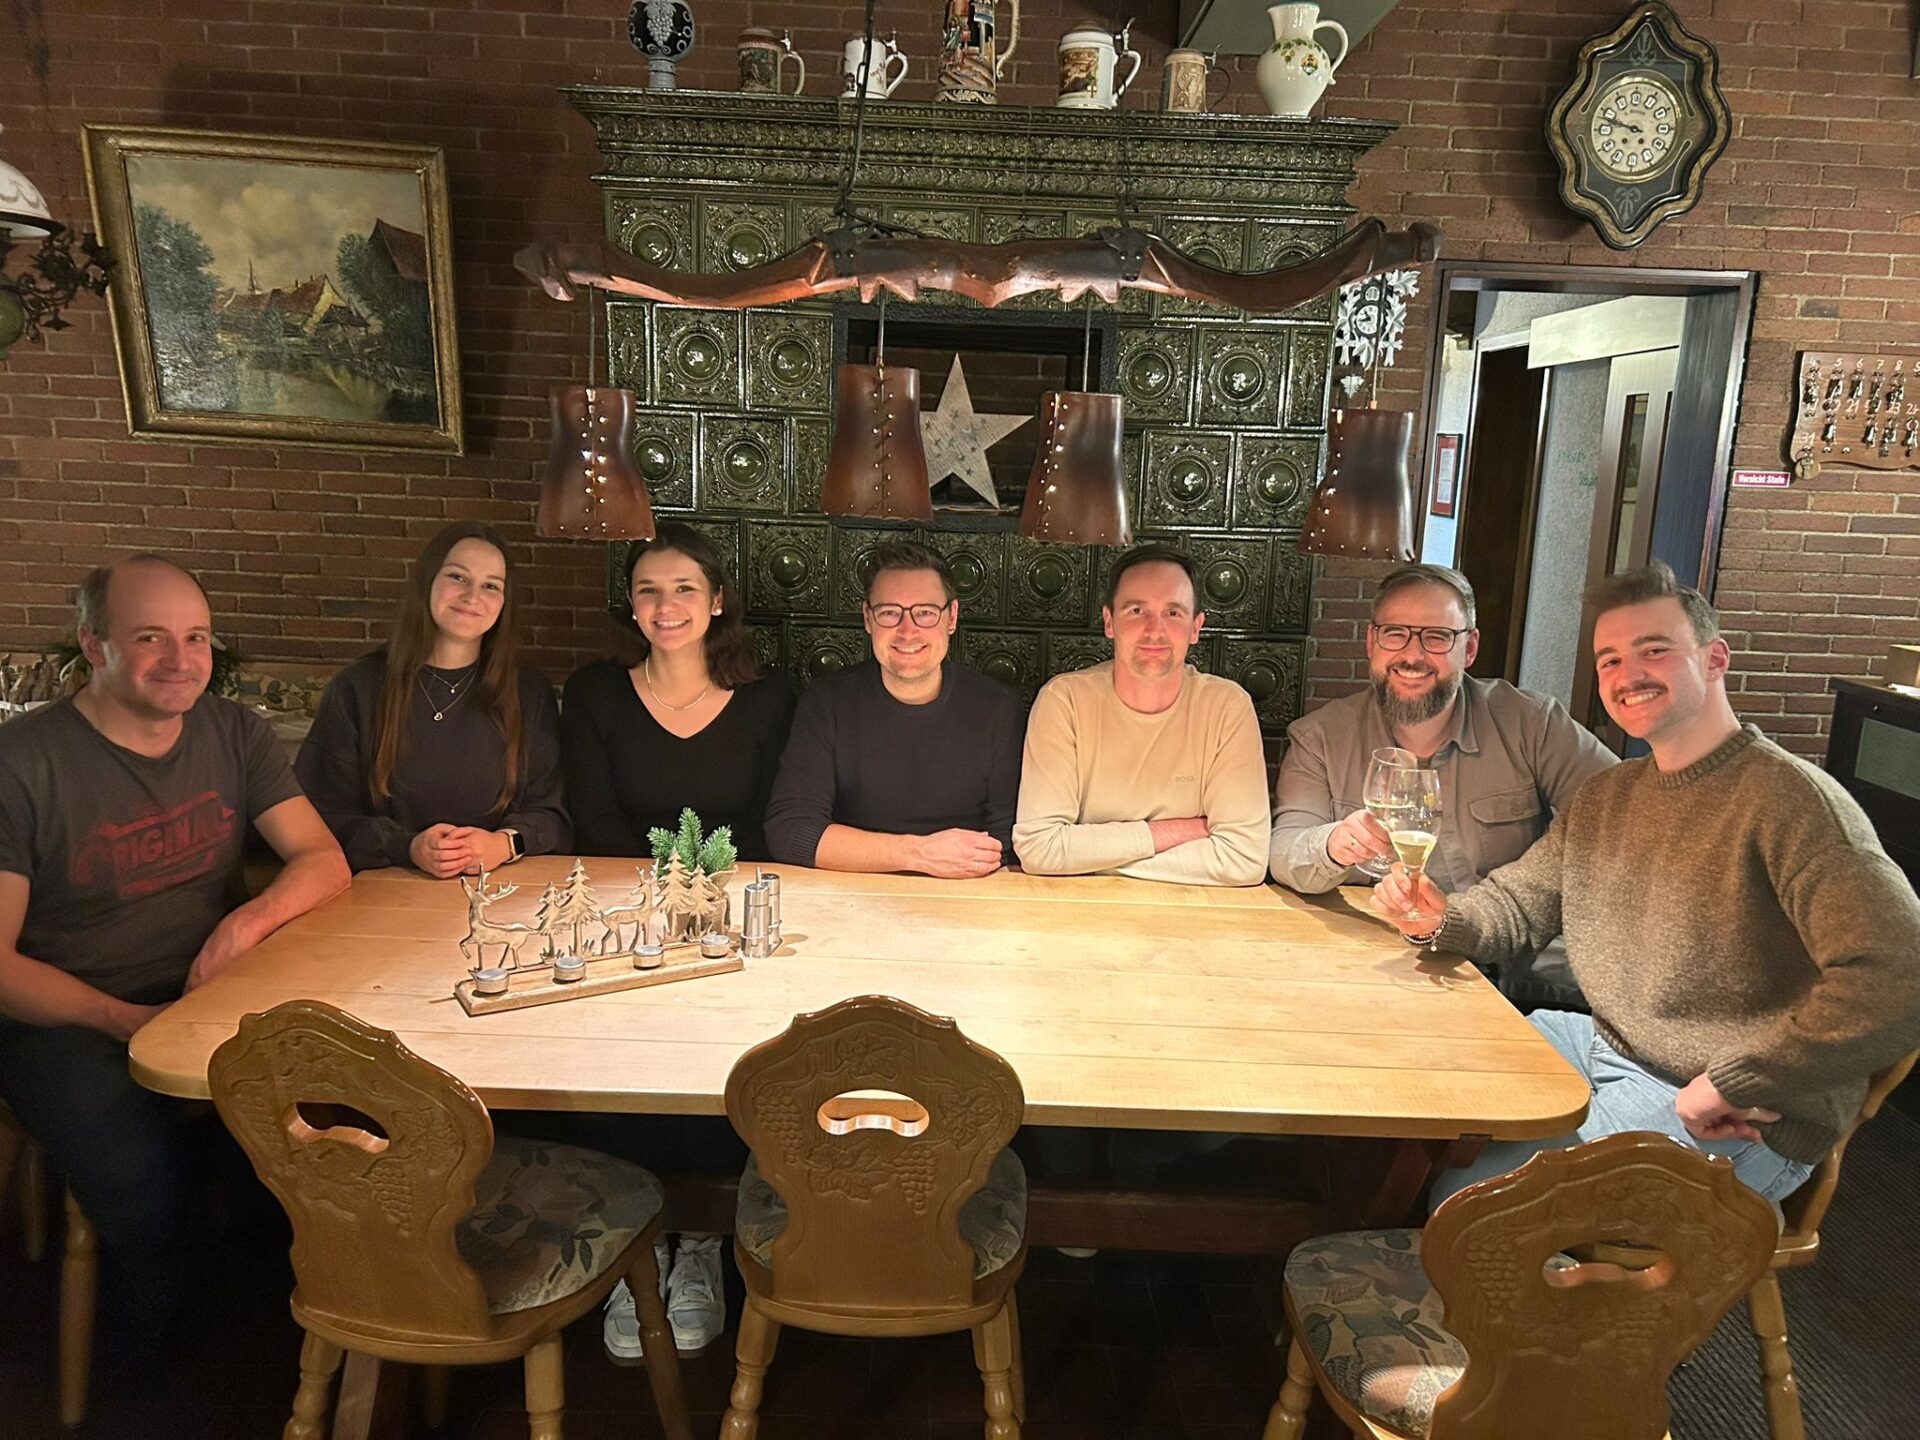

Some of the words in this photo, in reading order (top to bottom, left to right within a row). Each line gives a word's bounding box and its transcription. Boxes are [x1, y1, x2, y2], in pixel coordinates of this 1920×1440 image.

[1834, 358, 1843, 367] 5
[1856, 358, 1864, 368] 6
[1876, 360, 1885, 370] 7
[1894, 360, 1903, 371] 8
[1846, 399, 1860, 413] 21
